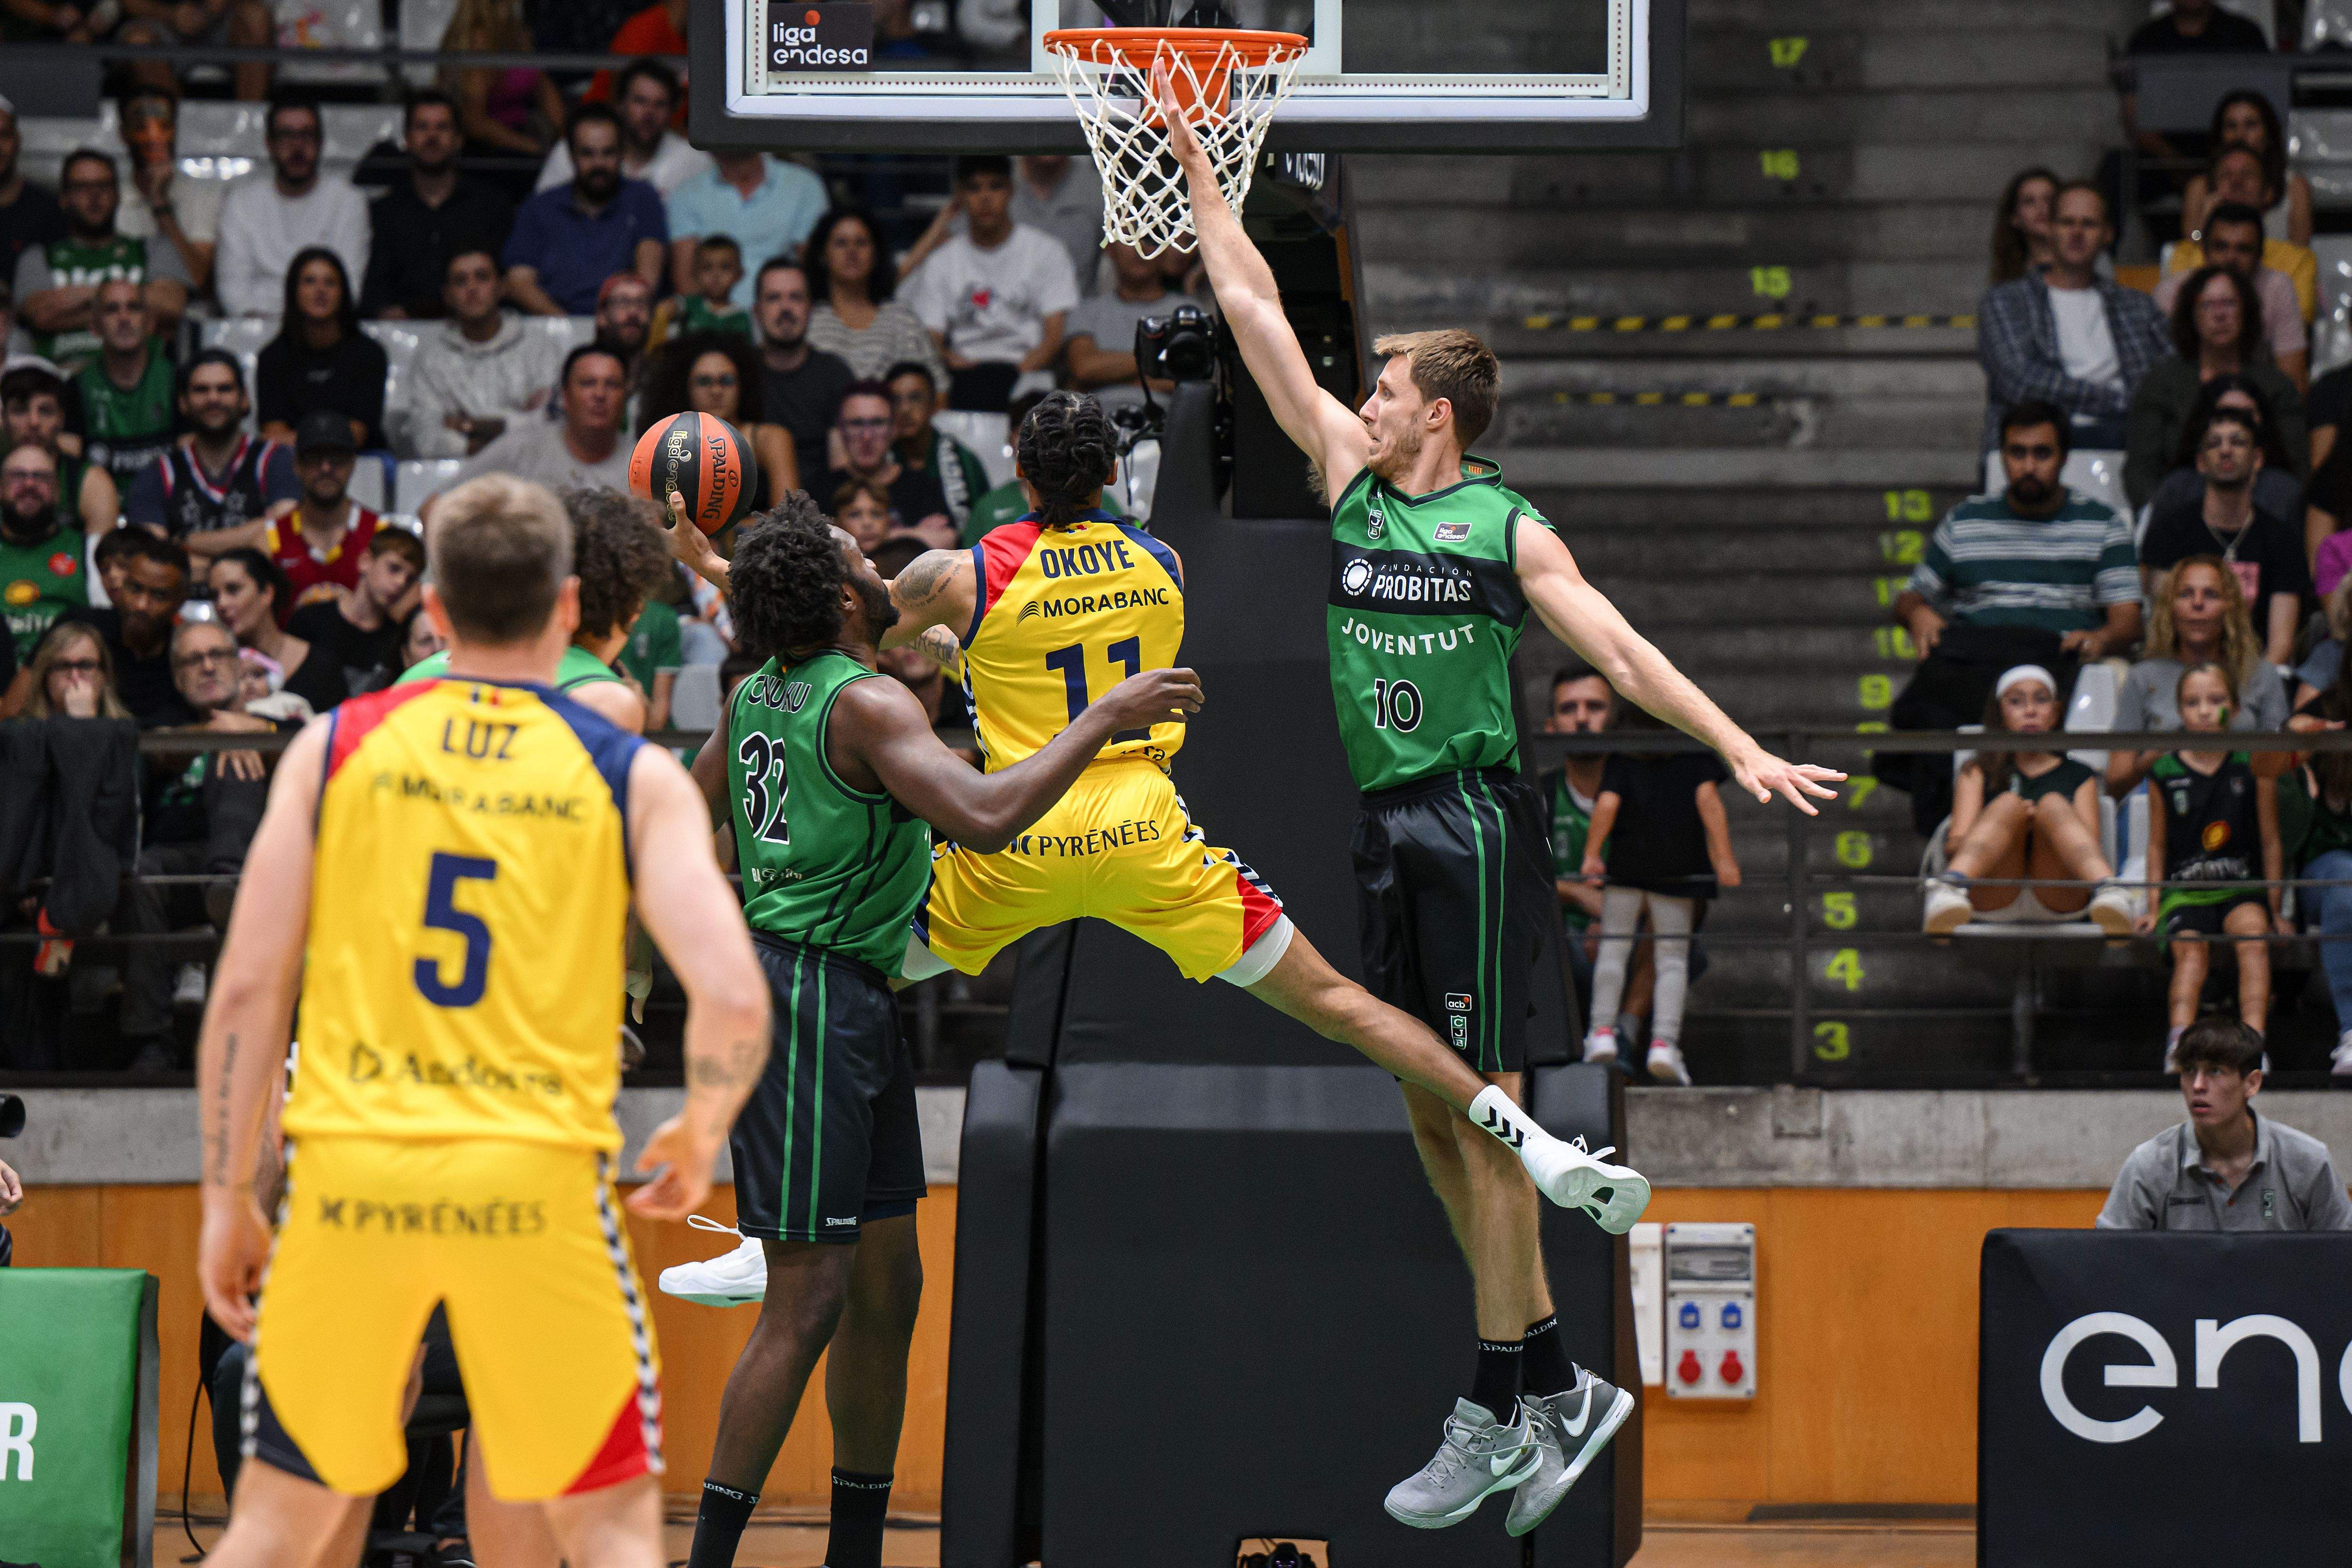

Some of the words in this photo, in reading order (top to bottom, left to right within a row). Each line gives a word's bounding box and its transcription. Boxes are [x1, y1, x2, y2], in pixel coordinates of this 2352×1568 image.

[773, 22, 815, 45] liga
[773, 44, 867, 64] endesa
[705, 436, 727, 520] SPALDING
[1884, 489, 1933, 522] 13
[1040, 540, 1135, 578] OKOYE
[1880, 530, 1923, 564] 12
[1043, 588, 1169, 618] MORABANC
[1372, 574, 1471, 602] PROBITAS
[1342, 617, 1474, 656] JOVENTUT
[1373, 678, 1423, 732] 10
[1859, 674, 1892, 709] 9
[442, 717, 520, 759] LUZ
[739, 731, 790, 845] 32
[1847, 776, 1878, 810] 7
[1836, 831, 1872, 868] 6
[1823, 892, 1858, 929] 5
[415, 852, 498, 1008] 5
[1826, 948, 1865, 991] 4
[1448, 1000, 1465, 1009] acb
[1814, 1021, 1850, 1061] 3
[2040, 1312, 2352, 1443] en
[0, 1402, 38, 1481] R
